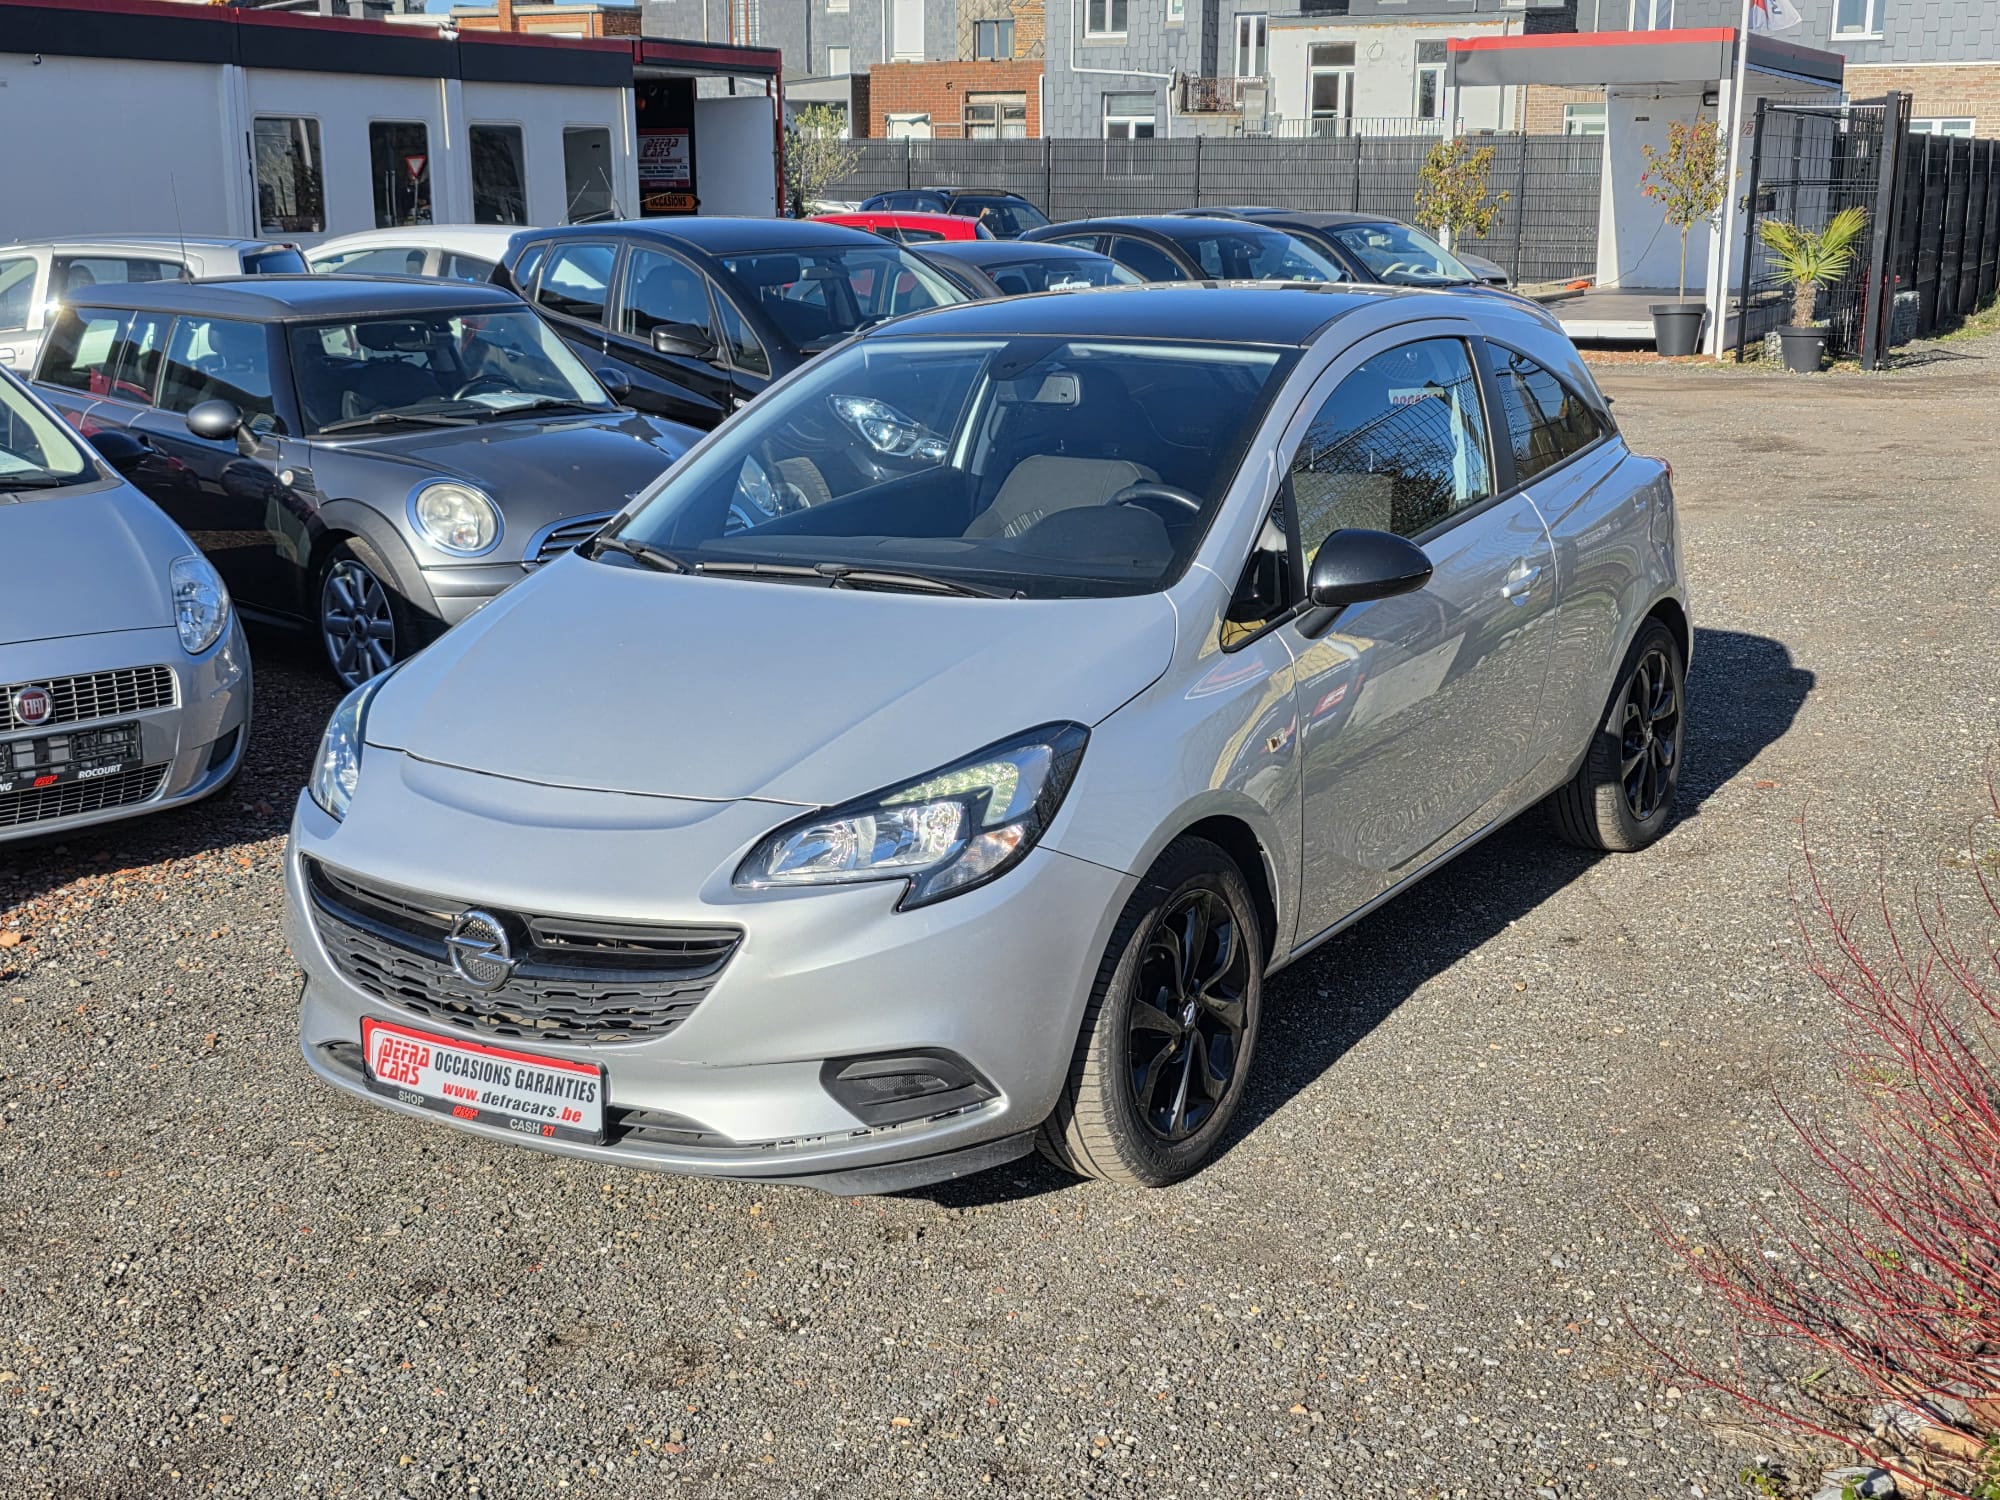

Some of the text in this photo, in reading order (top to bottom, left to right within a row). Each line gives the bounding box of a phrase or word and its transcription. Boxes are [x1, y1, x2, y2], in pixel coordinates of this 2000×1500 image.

[650, 195, 687, 207] OCCASIONS
[23, 697, 45, 716] FIAT
[78, 764, 122, 779] ROCOURT
[379, 1037, 431, 1068] DEFRA
[376, 1058, 420, 1086] CARS
[435, 1051, 597, 1103] OCCASIONS GARANTIES
[398, 1090, 425, 1107] SHOP
[509, 1118, 541, 1136] CASH
[442, 1082, 582, 1123] www.defracars.be
